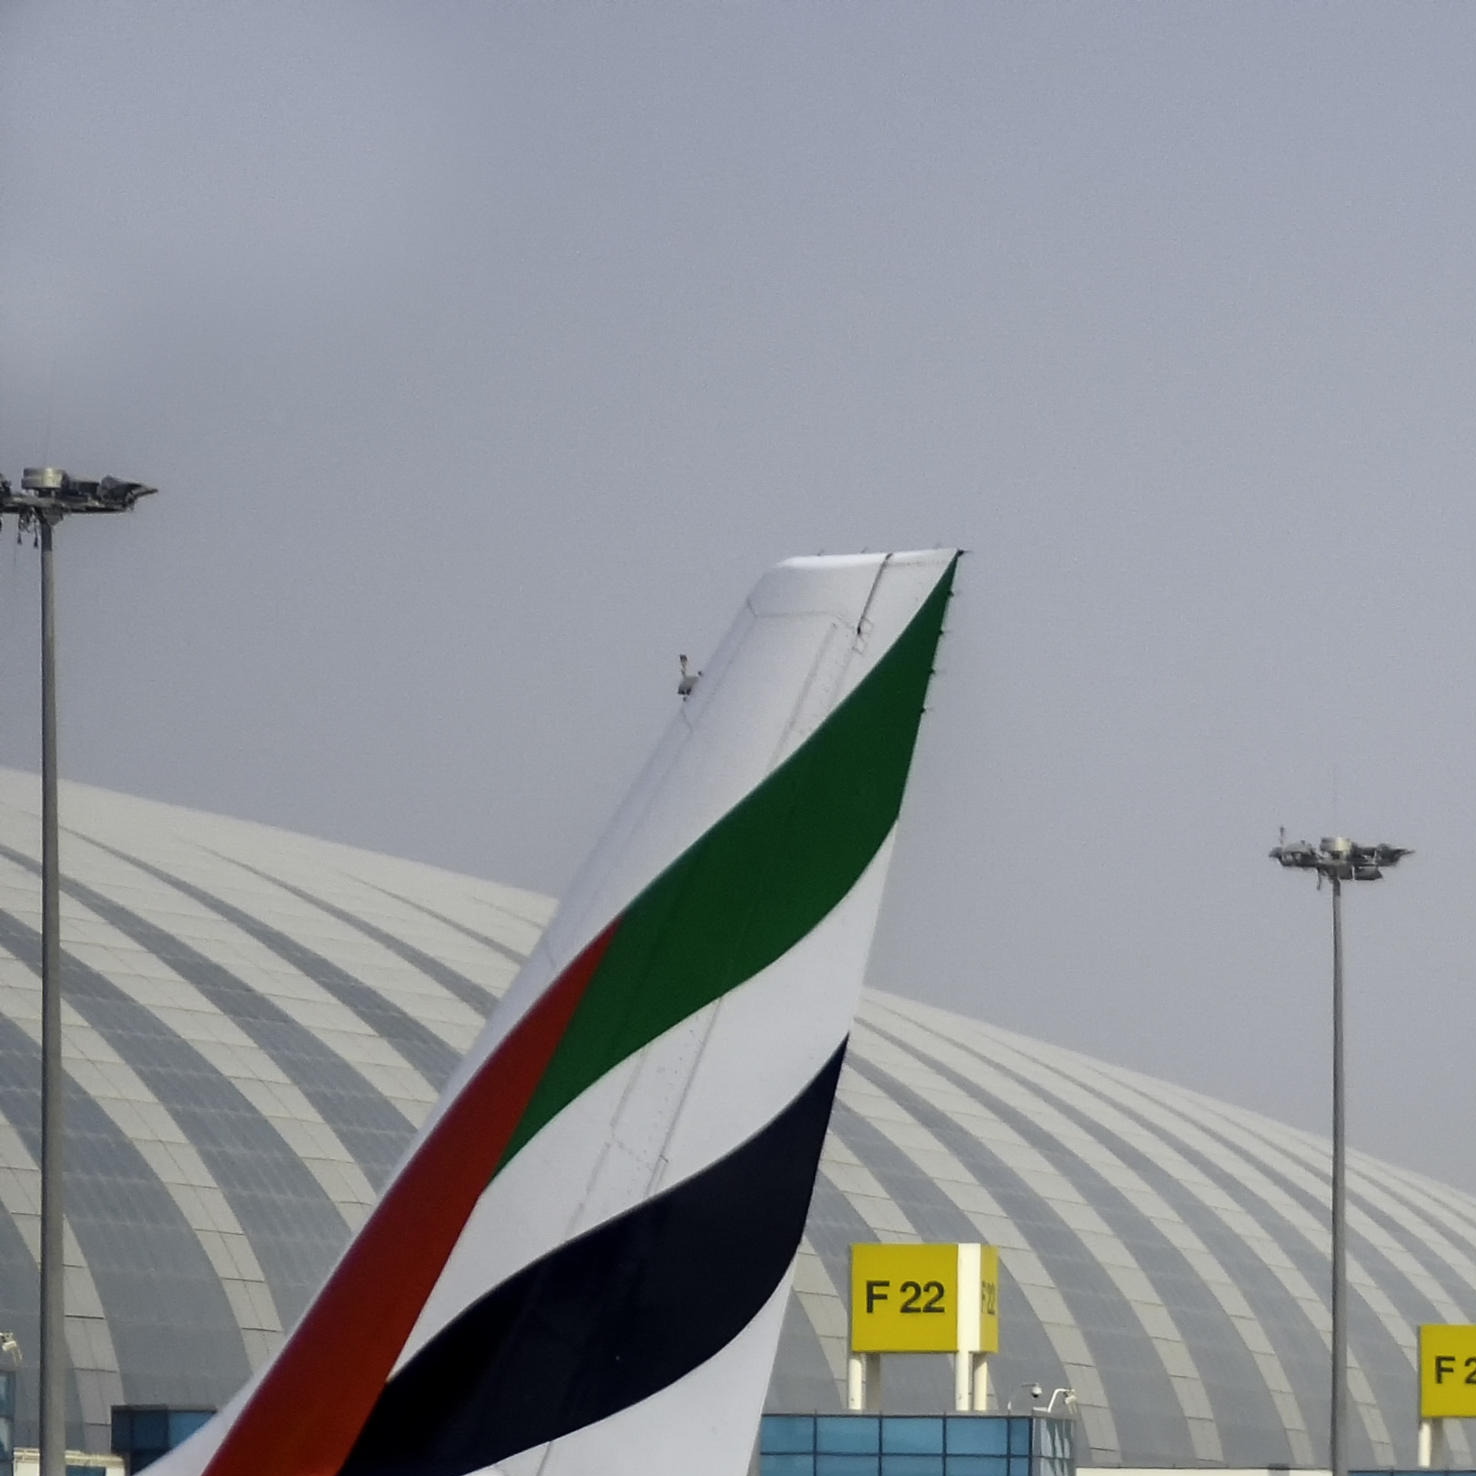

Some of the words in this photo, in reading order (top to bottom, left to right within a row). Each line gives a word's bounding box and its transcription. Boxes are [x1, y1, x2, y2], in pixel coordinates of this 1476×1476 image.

[866, 1280, 890, 1313] F
[900, 1280, 945, 1313] 22
[1435, 1356, 1456, 1384] F
